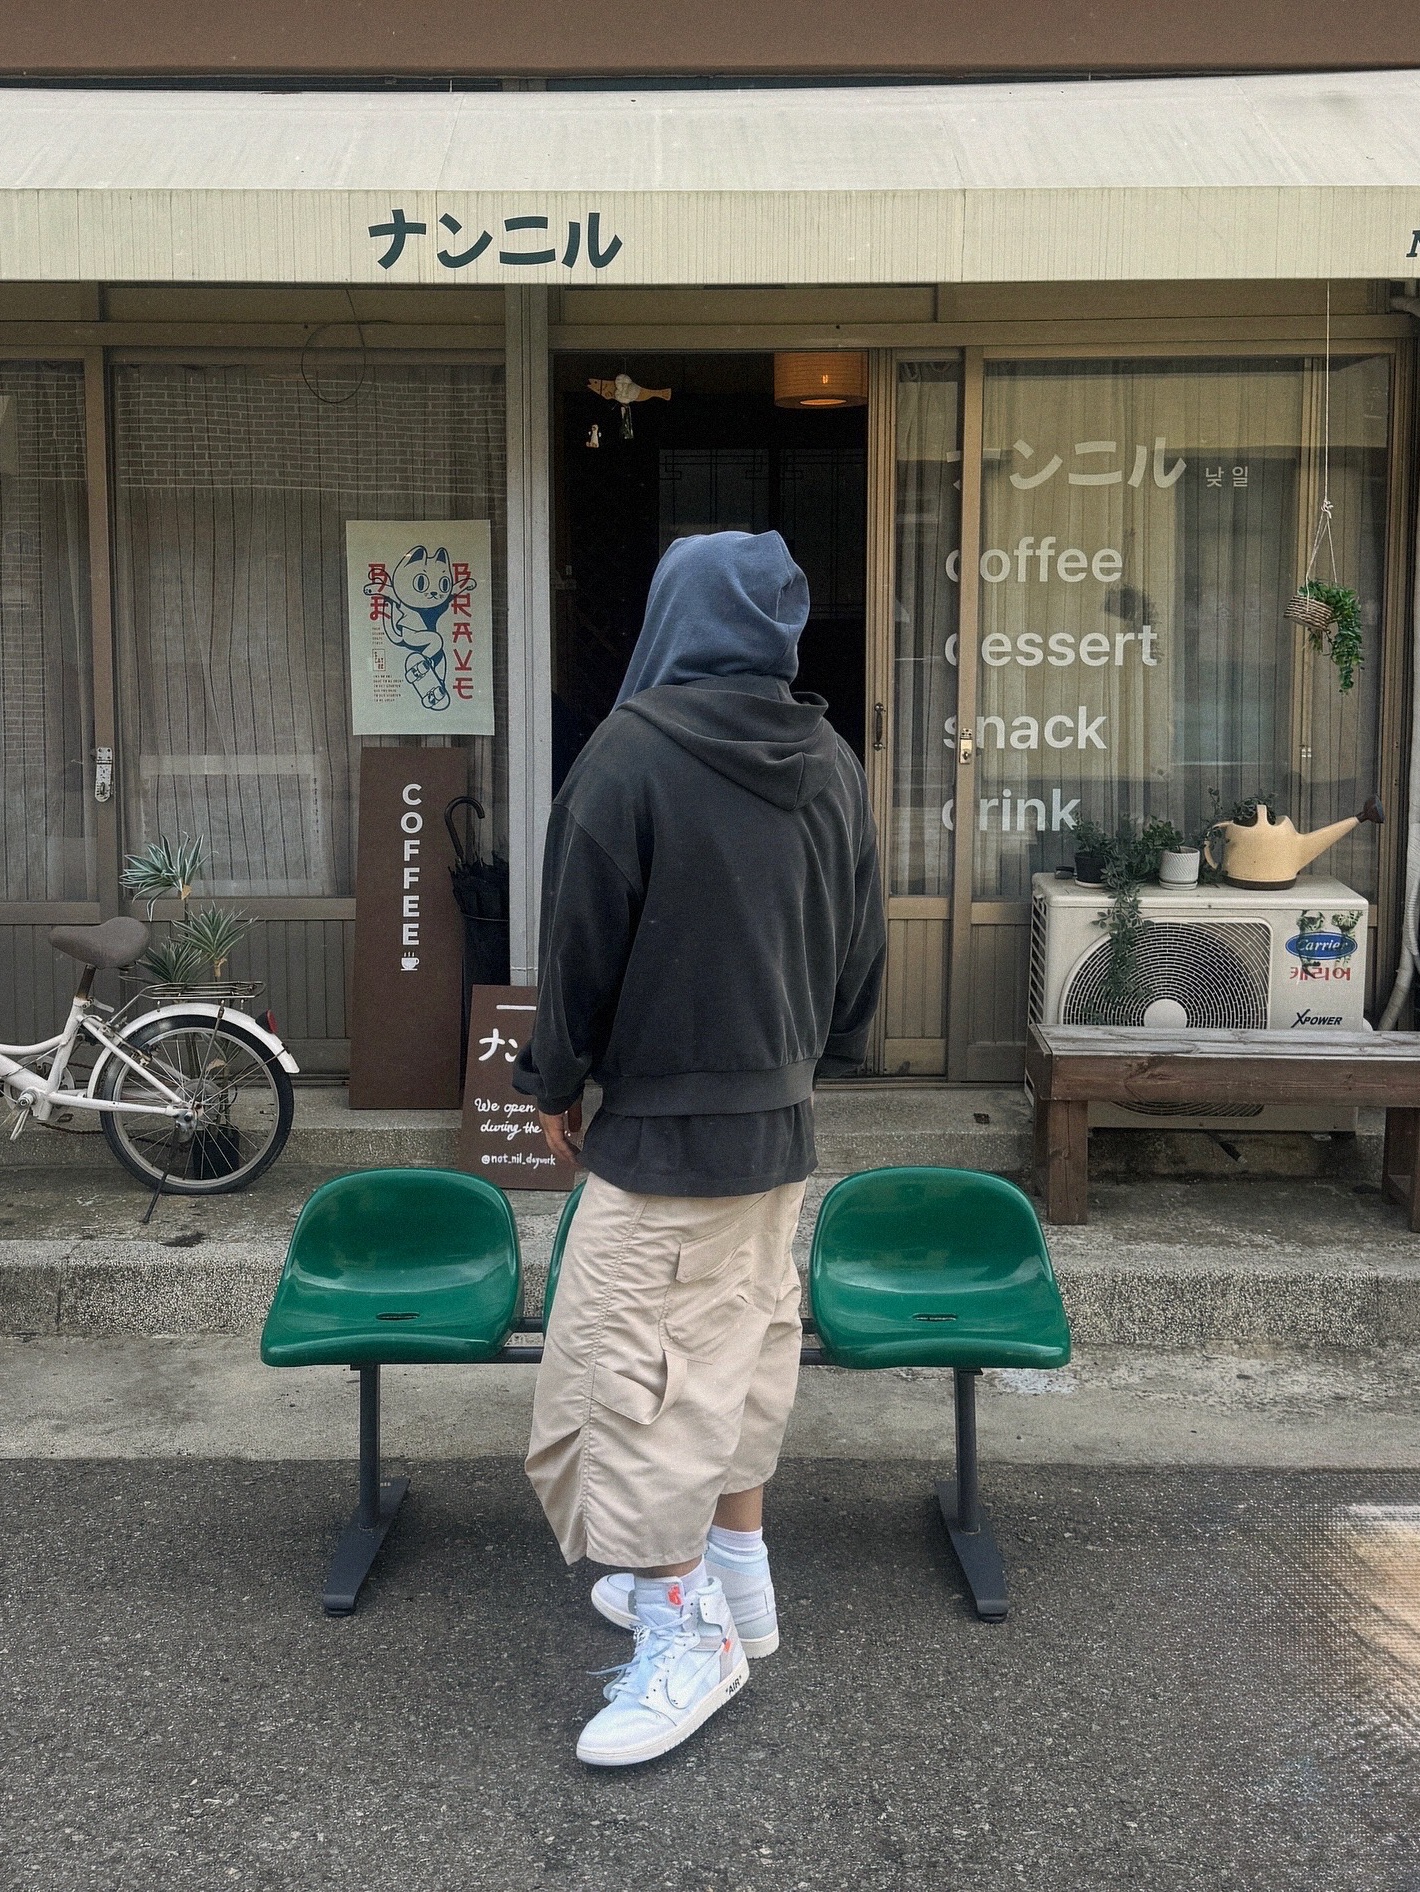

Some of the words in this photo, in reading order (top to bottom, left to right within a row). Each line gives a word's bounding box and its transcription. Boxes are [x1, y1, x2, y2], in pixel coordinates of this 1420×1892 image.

[368, 208, 623, 269] ナンニル
[946, 437, 1187, 489] ンニル
[451, 563, 474, 700] BRAVE
[400, 783, 424, 946] COFFEE
[1297, 938, 1349, 952] Carrier
[1290, 1008, 1343, 1029] XPOWER
[474, 1098, 500, 1112] We
[504, 1103, 536, 1118] open
[480, 1119, 522, 1140] during
[522, 1121, 542, 1134] the
